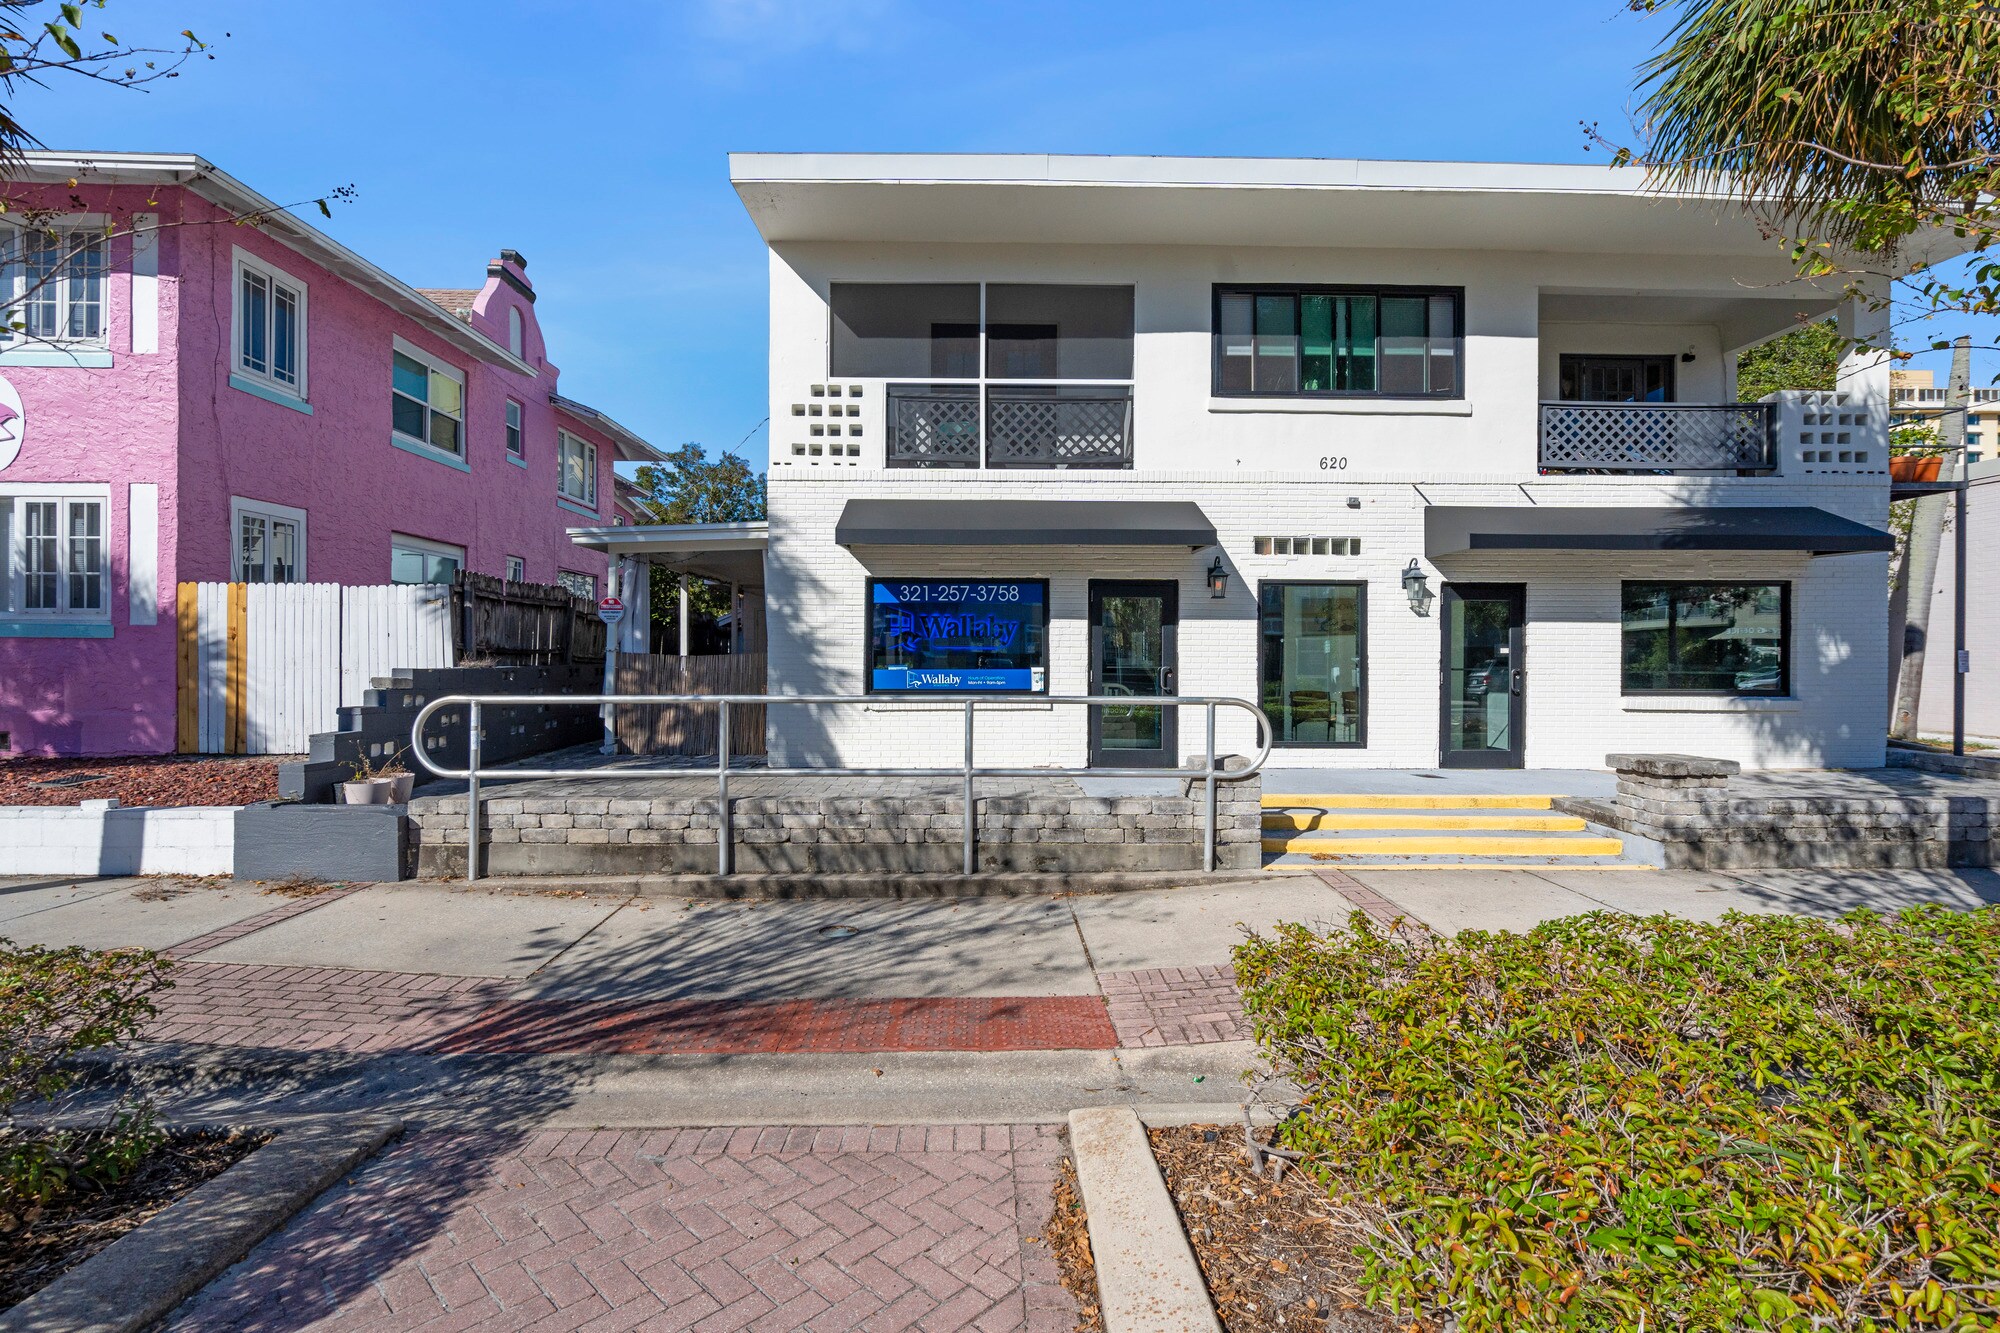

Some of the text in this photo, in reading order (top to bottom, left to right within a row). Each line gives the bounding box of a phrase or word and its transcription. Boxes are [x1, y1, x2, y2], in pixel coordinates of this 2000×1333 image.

[1320, 456, 1347, 470] 620
[899, 585, 1019, 601] 321-257-3758
[919, 614, 1018, 645] Wallaby
[921, 674, 962, 686] Wallaby
